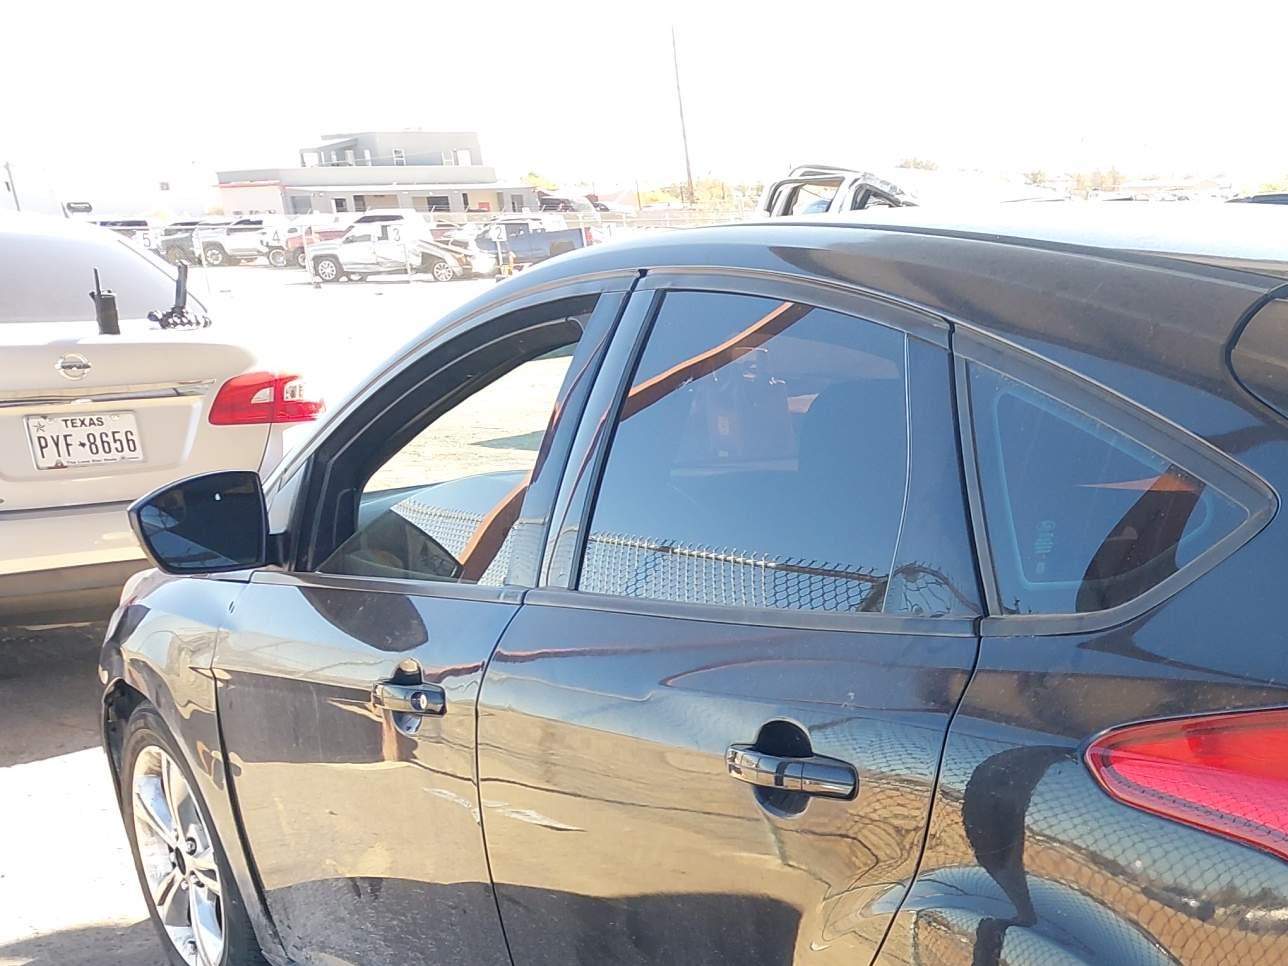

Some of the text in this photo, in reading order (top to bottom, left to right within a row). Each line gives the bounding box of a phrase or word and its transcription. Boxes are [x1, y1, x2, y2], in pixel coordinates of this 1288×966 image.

[142, 232, 151, 248] 5
[494, 226, 503, 240] 2
[62, 416, 105, 429] TEXAS
[37, 430, 137, 459] PYF 8656
